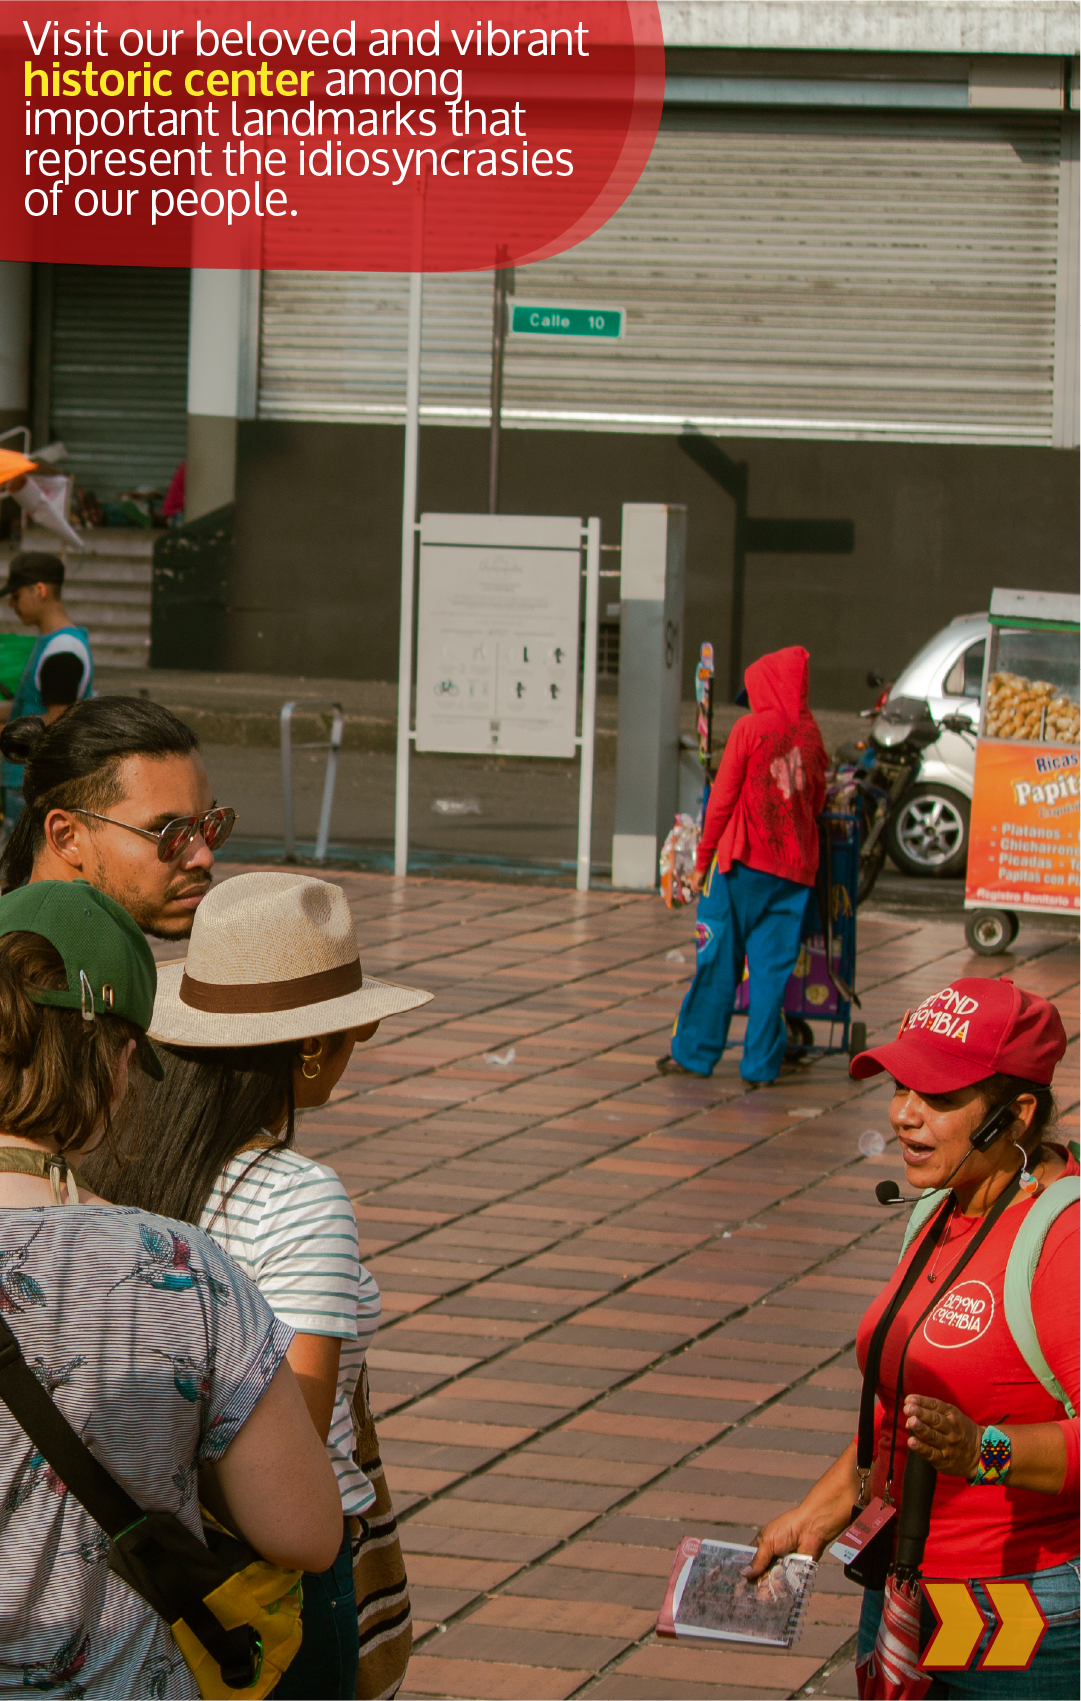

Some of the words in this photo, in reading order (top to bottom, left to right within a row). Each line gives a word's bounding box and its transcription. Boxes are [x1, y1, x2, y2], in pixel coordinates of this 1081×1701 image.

[529, 312, 571, 328] Calle
[589, 315, 605, 330] 10
[1036, 753, 1079, 773] Ricas
[999, 852, 1053, 870] Picadas
[998, 867, 1041, 884] Papitas
[1043, 873, 1064, 885] con
[976, 887, 1021, 903] Registro
[1023, 891, 1070, 907] Sanitario
[943, 1293, 986, 1315] BEYOND
[932, 1307, 981, 1333] COLOMBIA
